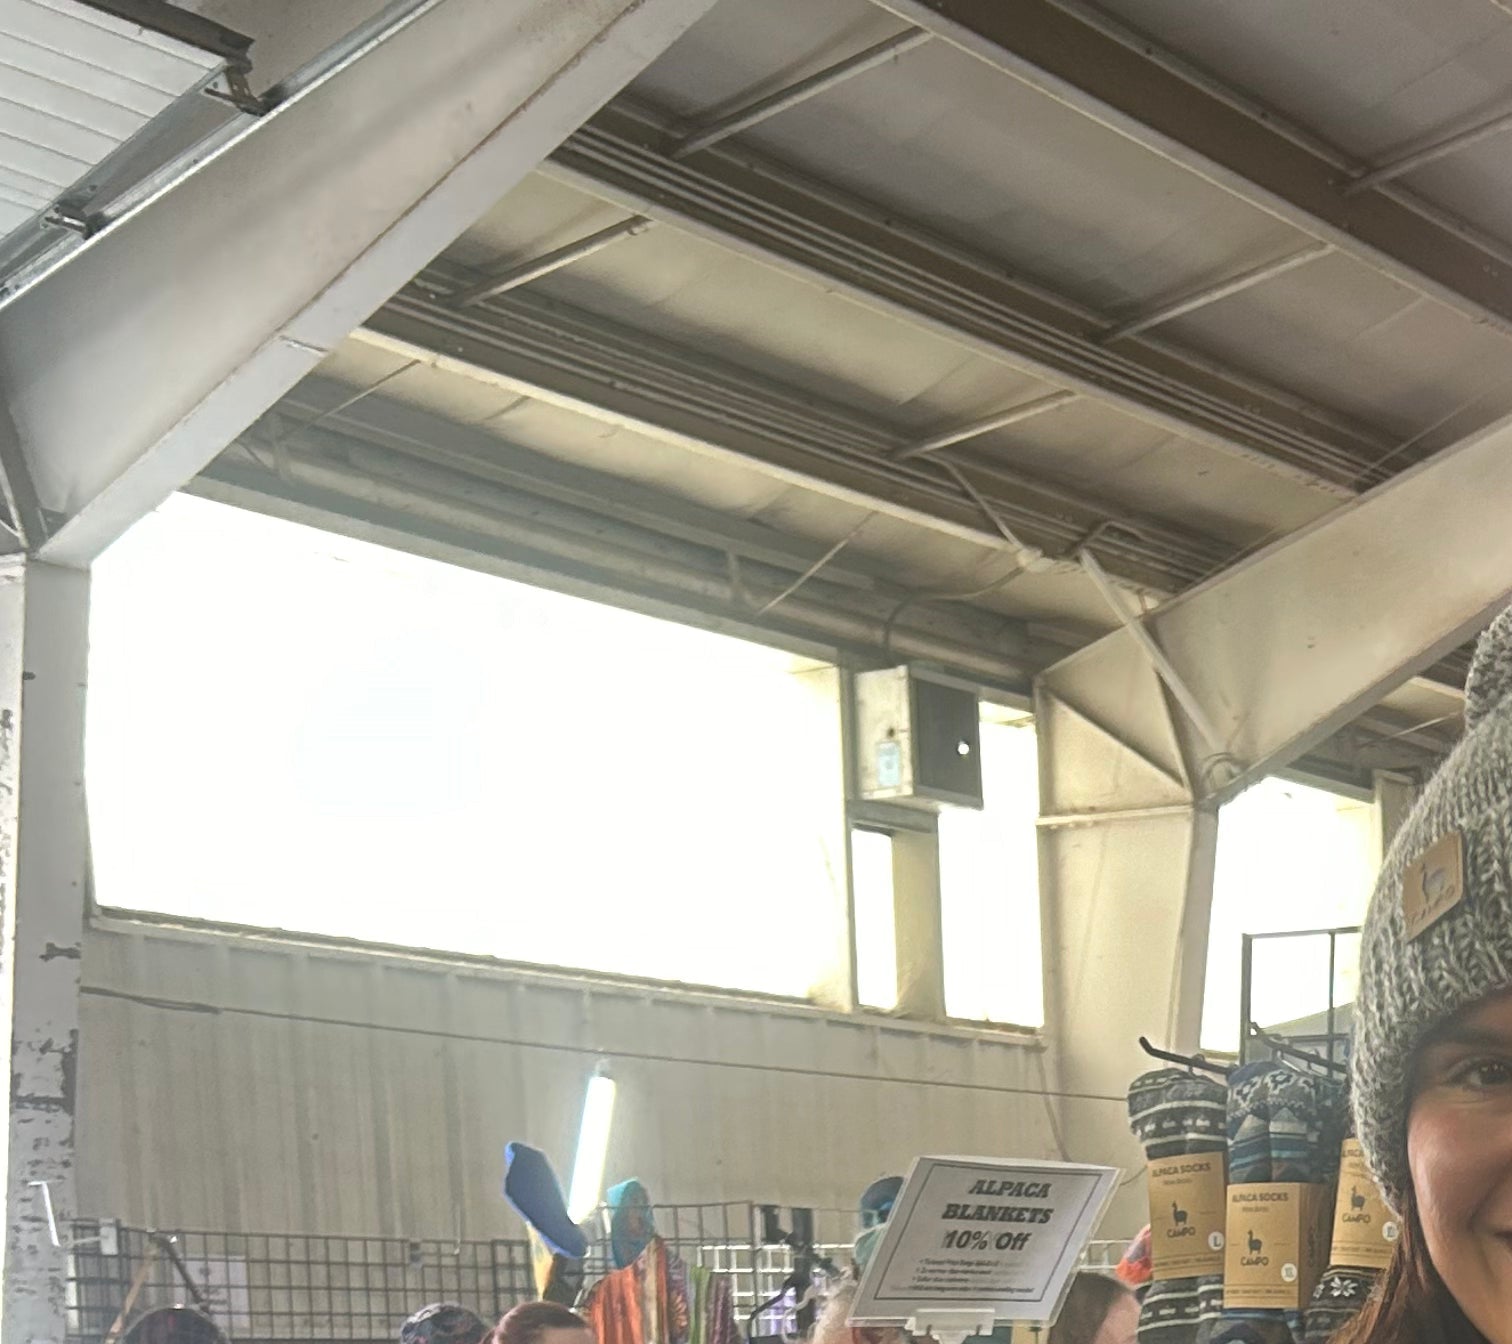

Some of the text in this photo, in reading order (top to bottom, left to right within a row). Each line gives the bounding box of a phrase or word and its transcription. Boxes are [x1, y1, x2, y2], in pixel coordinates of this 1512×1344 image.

[1181, 1162, 1211, 1173] SOCKS
[969, 1180, 1052, 1198] ALPACA
[1260, 1192, 1288, 1202] SOCKS
[942, 1203, 1054, 1224] BLANKETS
[1167, 1227, 1195, 1238] CAMPO
[945, 1230, 1032, 1251] 10% Off
[1214, 1236, 1220, 1247] L
[1240, 1257, 1269, 1266] CAMPO
